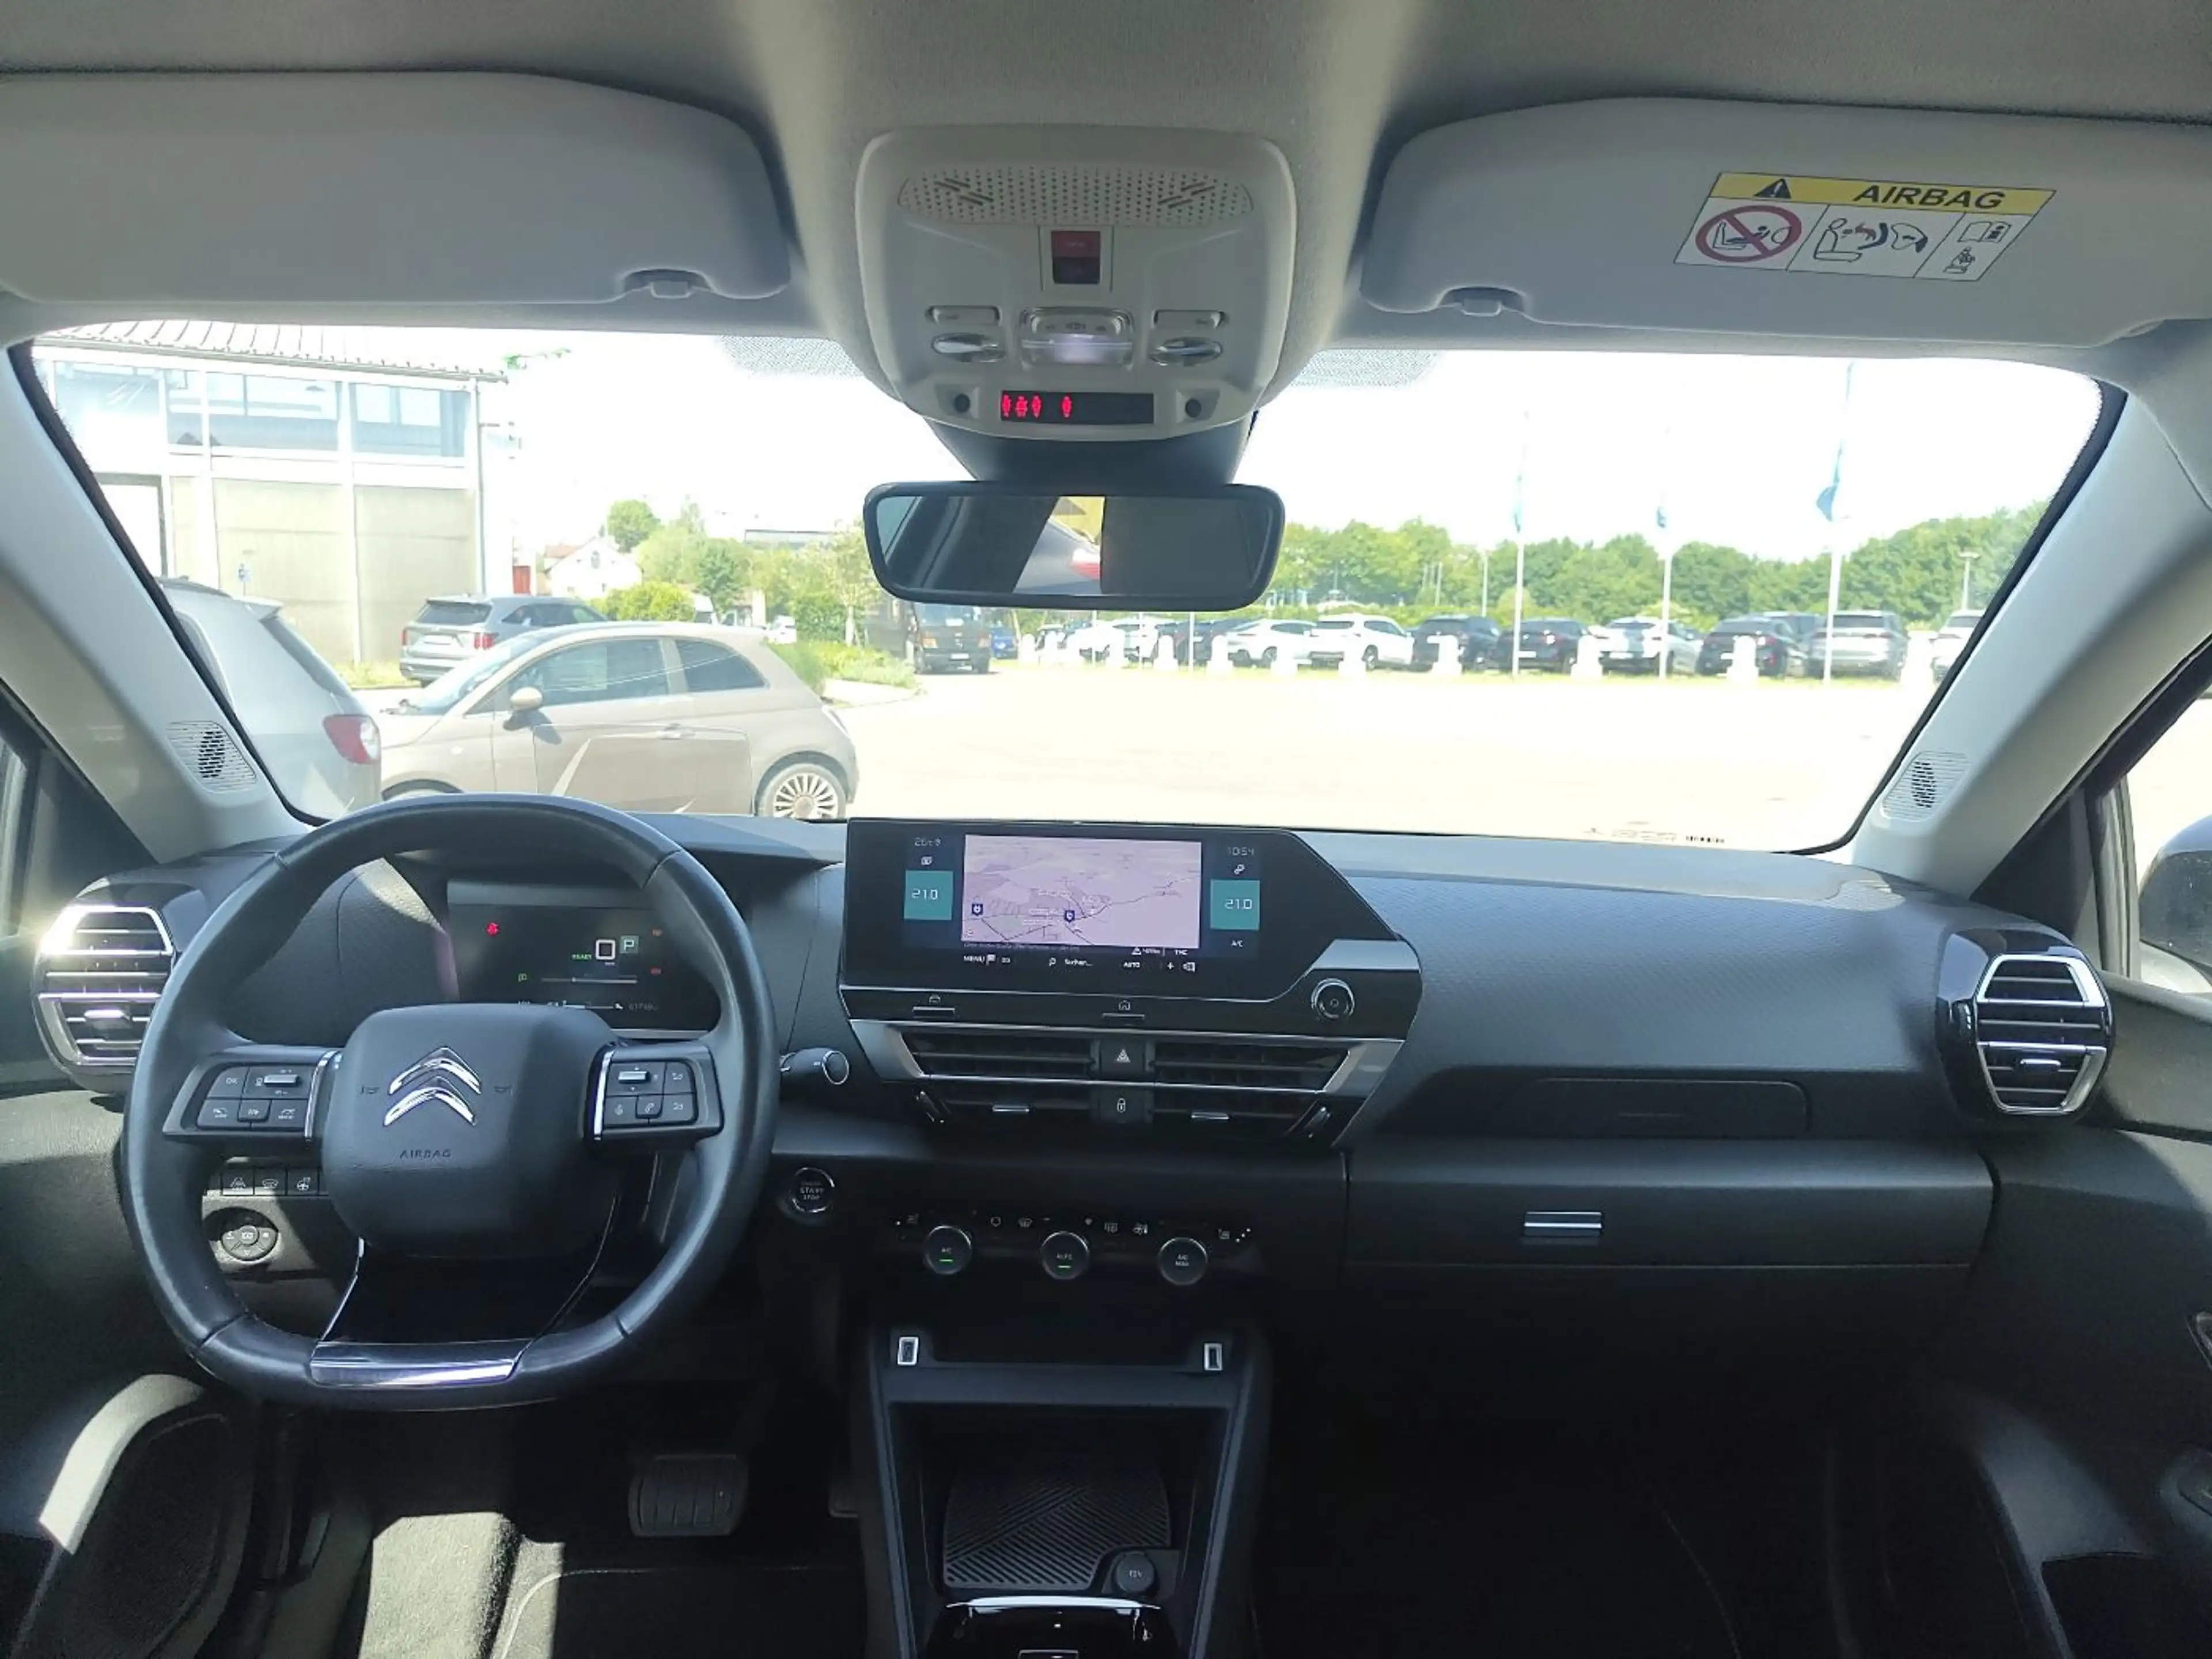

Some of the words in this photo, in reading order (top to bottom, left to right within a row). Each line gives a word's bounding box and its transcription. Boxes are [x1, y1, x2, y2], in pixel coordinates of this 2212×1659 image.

[1853, 185, 2005, 209] AIRBAG
[623, 940, 635, 950] P
[400, 1147, 452, 1160] AIRBAG
